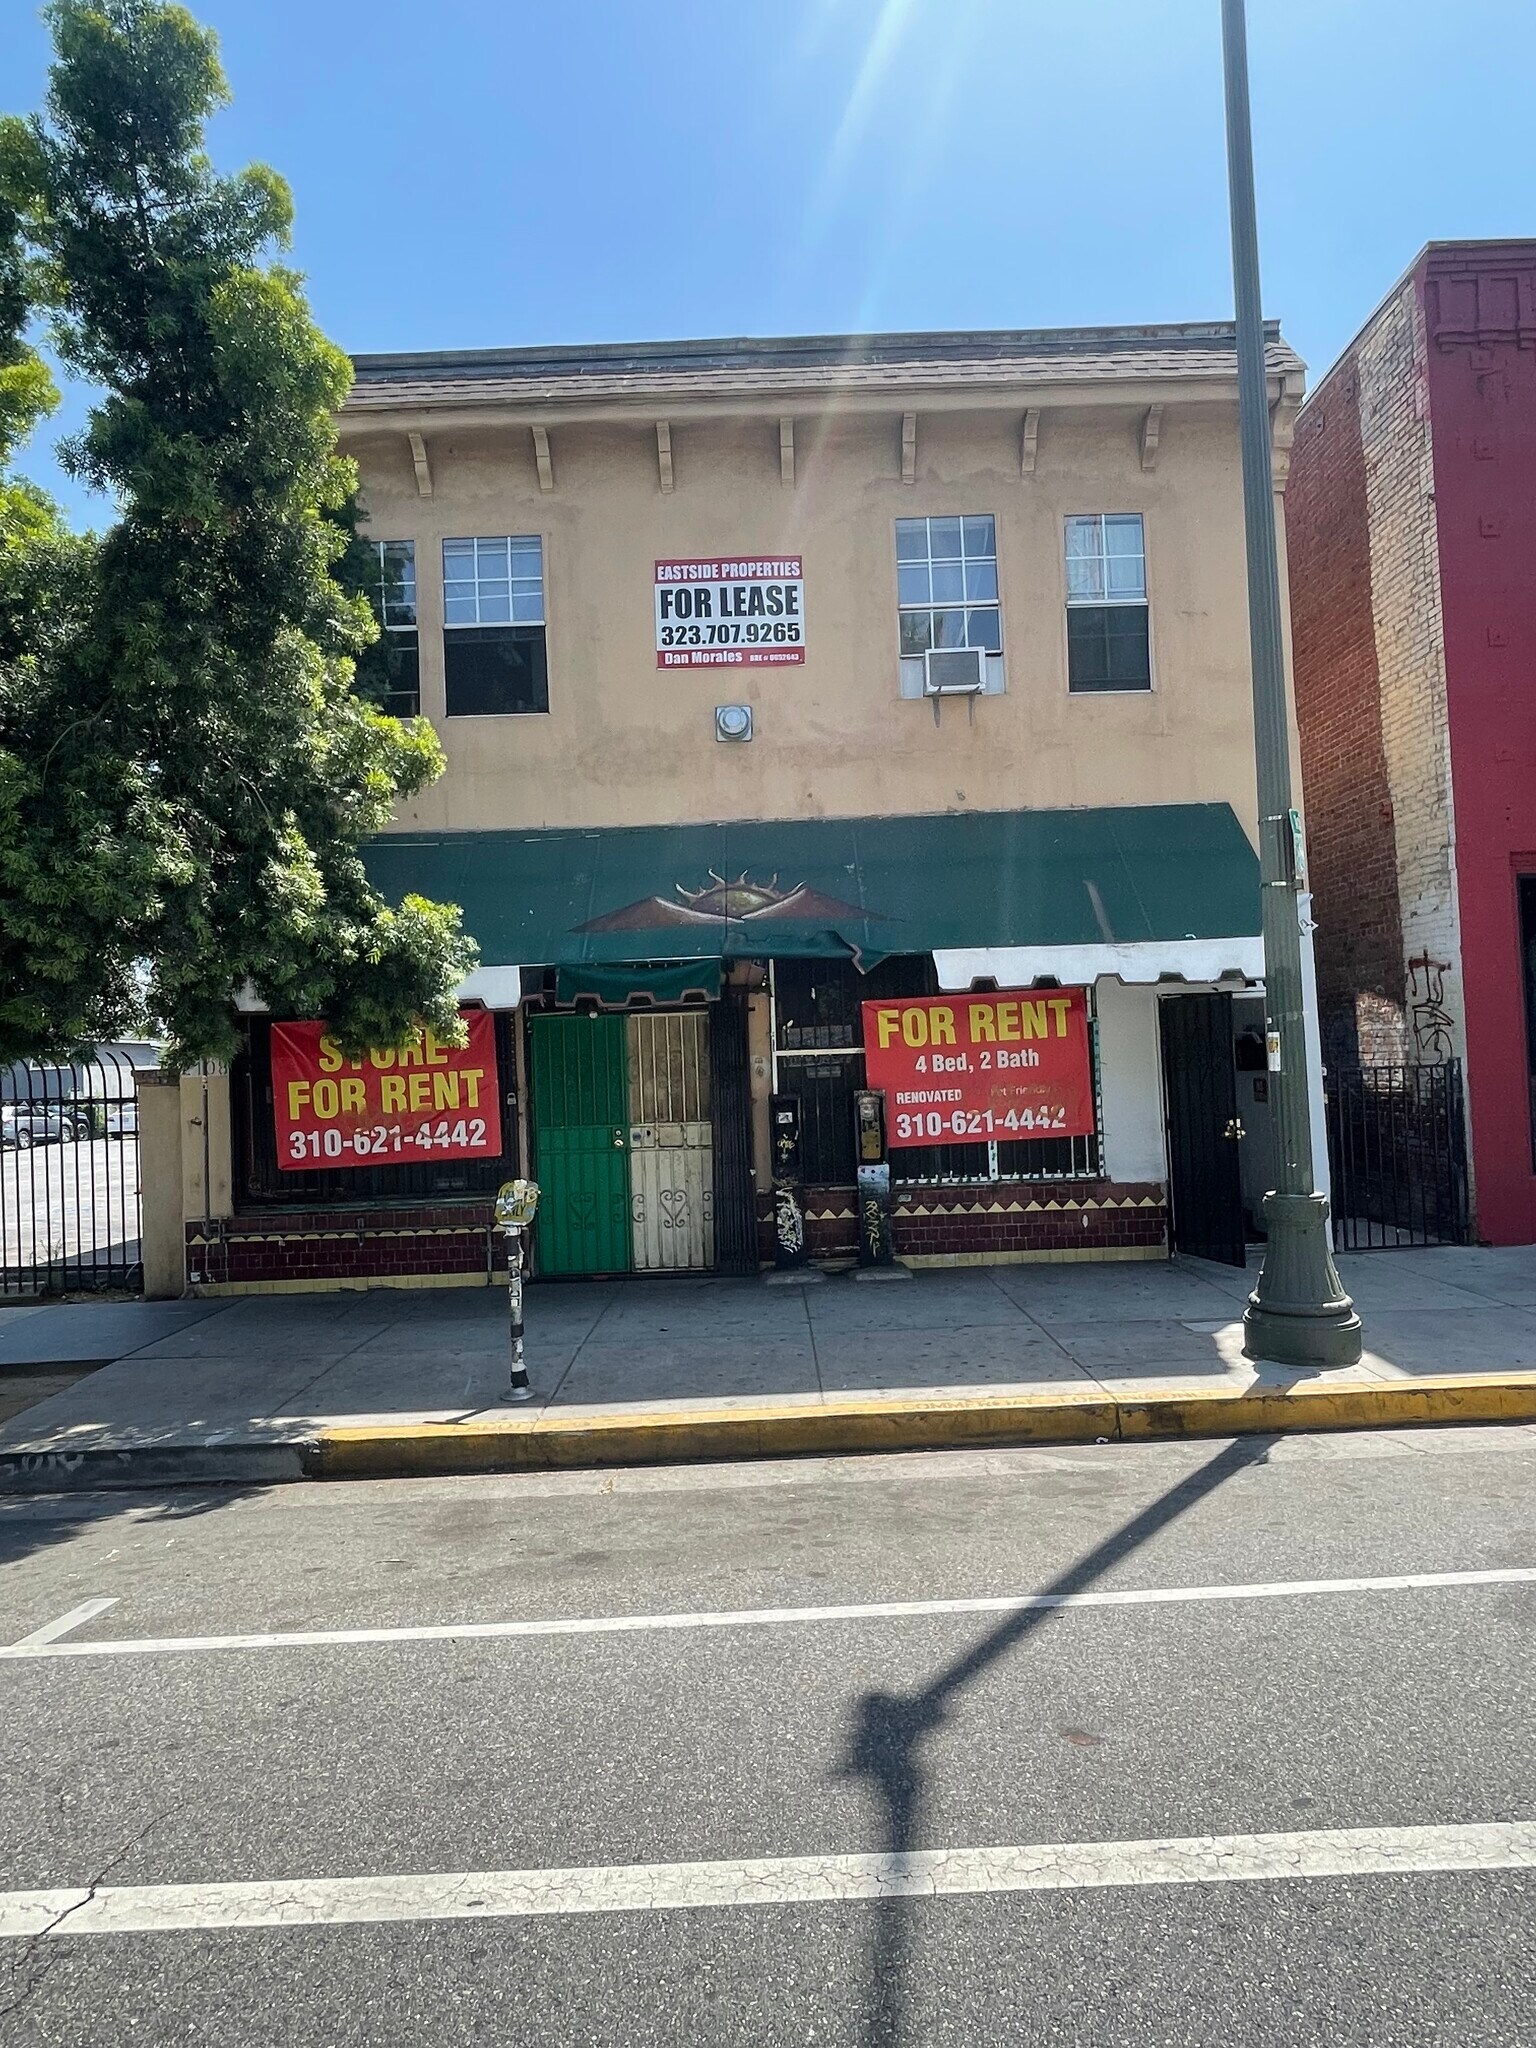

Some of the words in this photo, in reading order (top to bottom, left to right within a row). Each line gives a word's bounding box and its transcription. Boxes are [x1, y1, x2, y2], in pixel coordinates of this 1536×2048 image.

[657, 564, 719, 580] EASTSIDE
[721, 561, 800, 578] PROPERTIES
[660, 588, 712, 619] FOR
[720, 585, 799, 617] LEASE
[661, 622, 801, 646] 323.707.9265
[664, 652, 689, 665] Dan
[691, 650, 743, 664] Morales
[877, 1006, 957, 1049] FOR
[968, 999, 1072, 1043] RENT
[318, 1027, 449, 1073] SORE
[915, 1055, 927, 1073] 4
[932, 1052, 974, 1074] Bed,
[979, 1051, 992, 1070] 2
[997, 1048, 1040, 1069] Bath
[182, 1059, 228, 1075] 108
[287, 1078, 367, 1121] FOR
[380, 1068, 485, 1115] RENT
[896, 1088, 962, 1105] RENOVATED
[896, 1105, 1067, 1139] 310-621-4442
[289, 1118, 487, 1160] 310-621-4442
